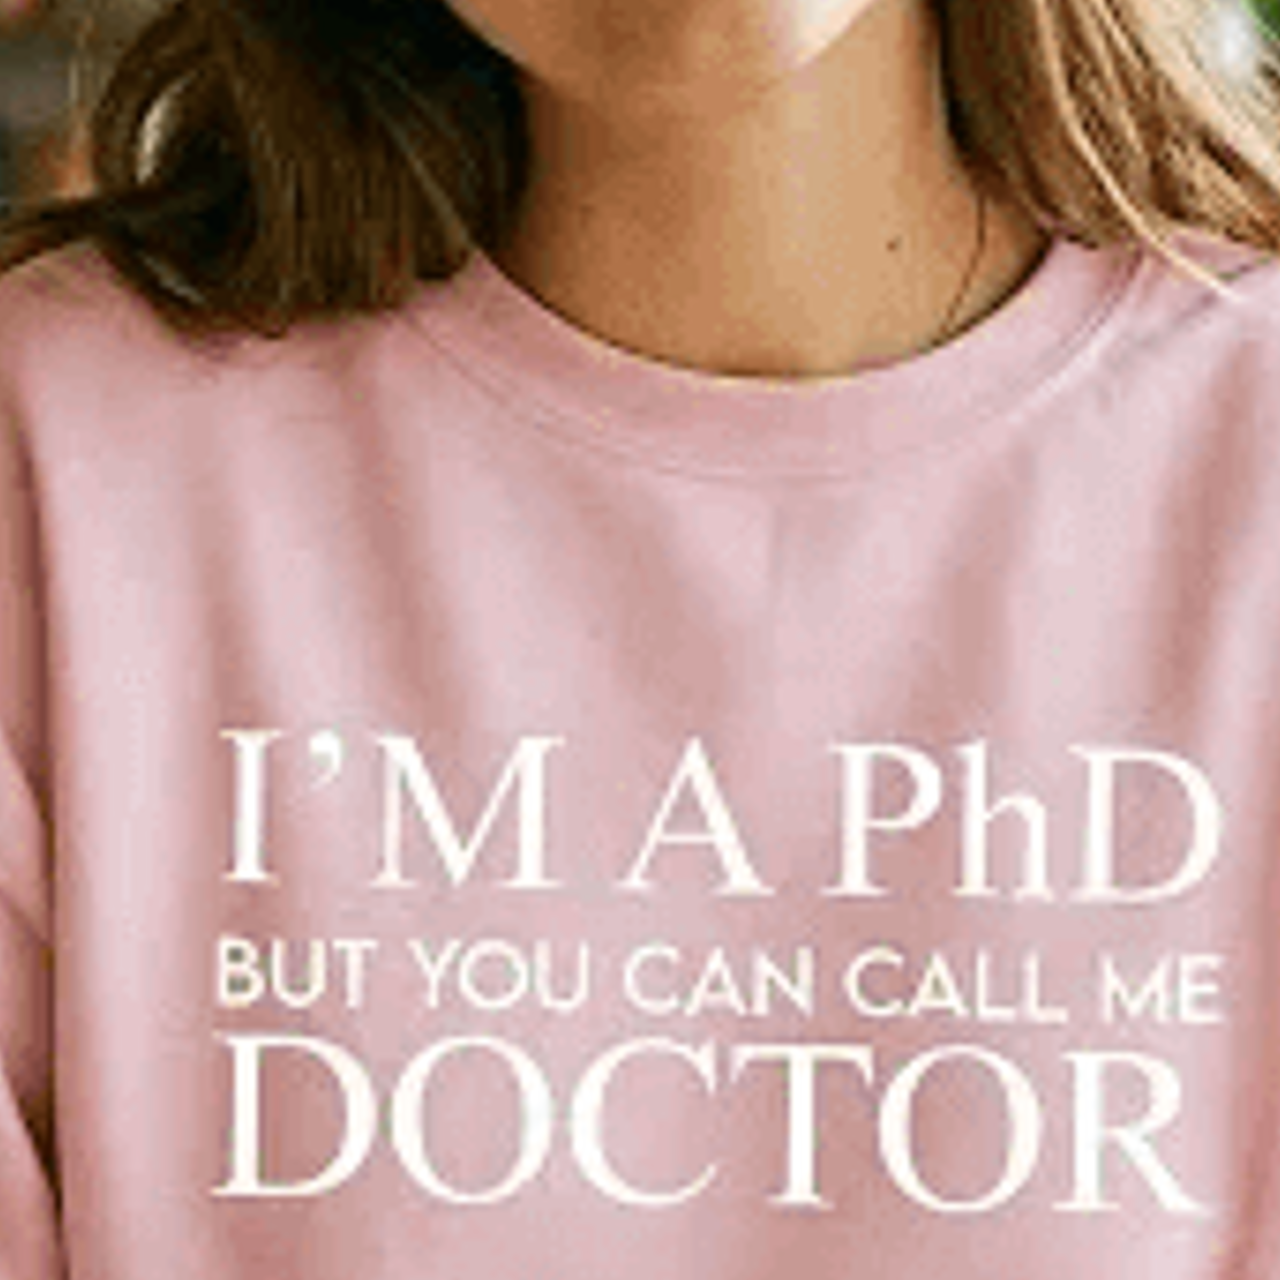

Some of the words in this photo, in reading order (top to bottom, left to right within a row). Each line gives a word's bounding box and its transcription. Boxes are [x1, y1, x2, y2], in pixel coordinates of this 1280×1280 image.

[615, 736, 775, 896] A
[822, 739, 1224, 904] PhD
[215, 935, 379, 1009] BUT
[407, 938, 590, 1013] YOU
[622, 944, 814, 1019] CAN
[844, 950, 1069, 1024] CALL
[1100, 953, 1225, 1026] ME
[210, 1031, 1210, 1217] DOCTOR
